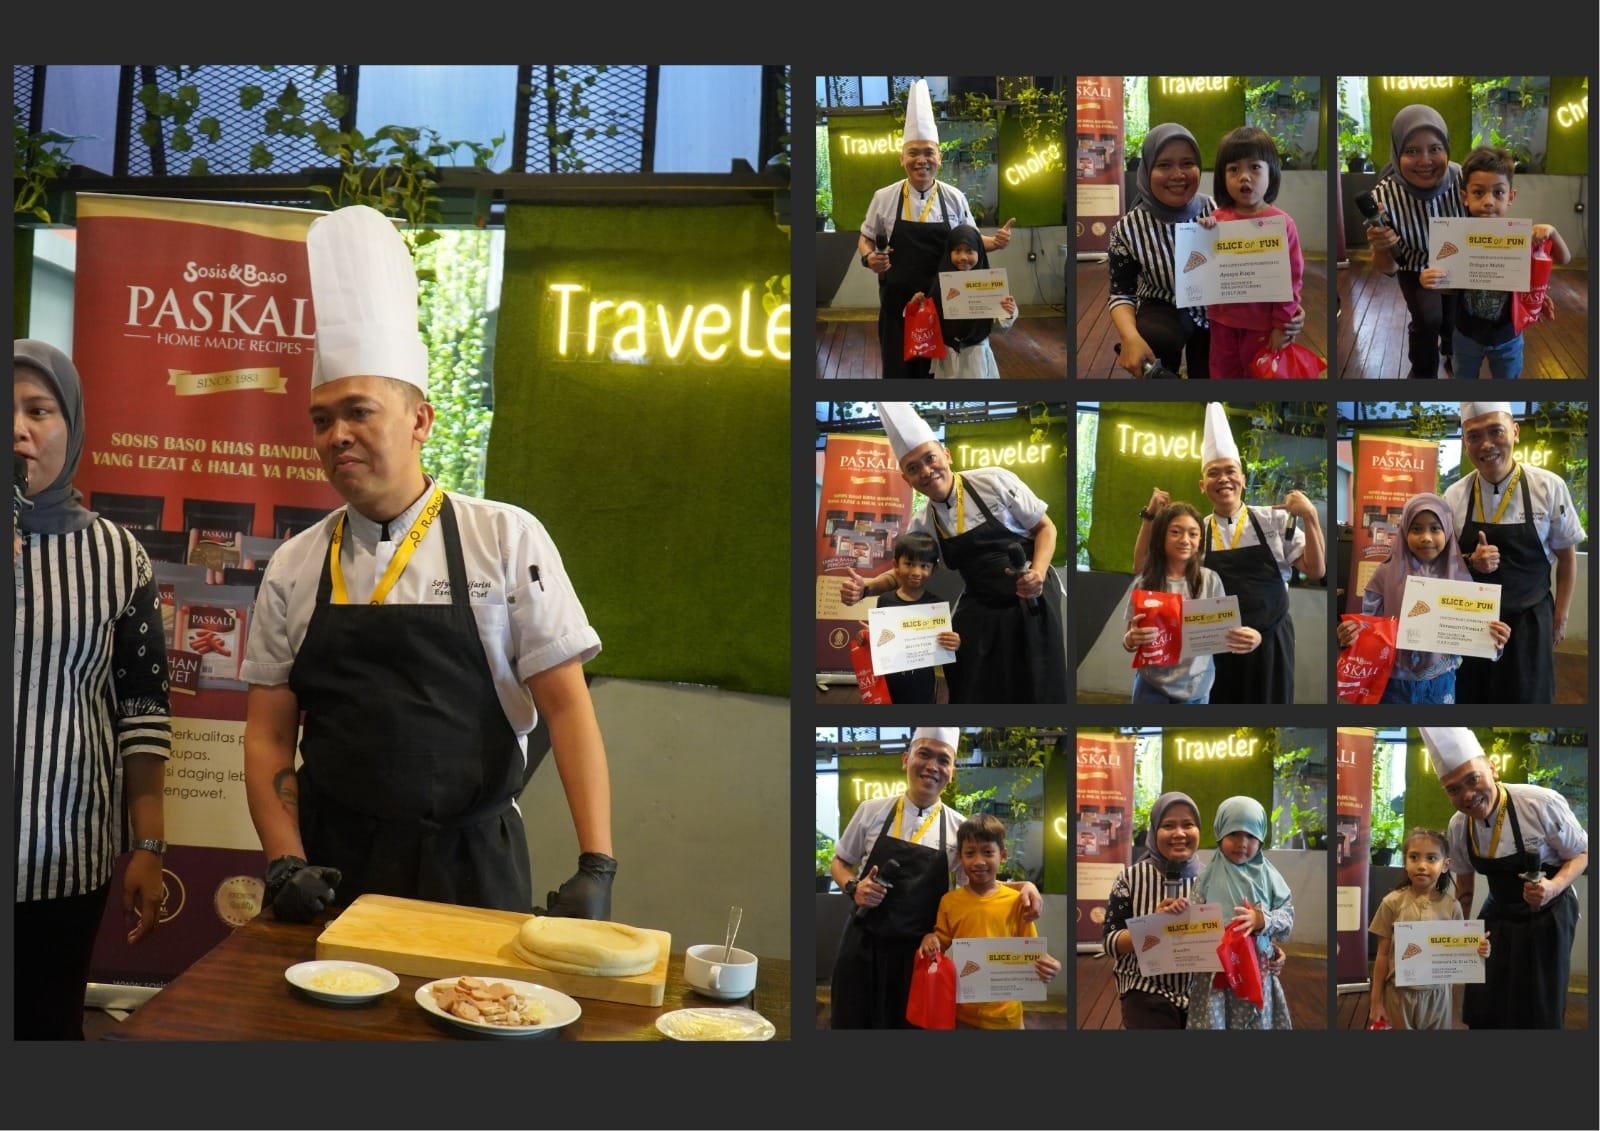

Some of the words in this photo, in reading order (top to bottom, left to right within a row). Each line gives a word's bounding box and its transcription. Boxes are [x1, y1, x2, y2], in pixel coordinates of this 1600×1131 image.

[1077, 85, 1112, 98] SKALI
[840, 134, 904, 156] Travele
[1216, 241, 1243, 250] SLICE
[1259, 239, 1280, 248] FUN
[1469, 236, 1493, 244] SLICE
[1506, 238, 1525, 246] FUN
[183, 261, 288, 287] Sosis&Baso
[124, 284, 316, 340] PASKAL
[548, 283, 792, 362] Travele
[157, 332, 201, 348] HOME
[204, 337, 246, 351] MADE
[250, 339, 303, 355] RECIPES
[196, 375, 232, 389] SINCE
[235, 373, 259, 385] 1983
[111, 432, 159, 449] SOSIS
[164, 436, 206, 453] BASO
[211, 440, 254, 457] KHAS
[259, 443, 321, 462] BANDUN
[1117, 423, 1204, 460] Travel
[840, 455, 900, 471] PASKALI
[957, 443, 1052, 467] Traveler
[1371, 455, 1425, 470] PASKALI
[1512, 446, 1553, 467] eler
[91, 451, 133, 468] YANG
[138, 455, 188, 472] LEZAT
[191, 458, 203, 473] &
[207, 460, 257, 477] HALAL
[261, 464, 281, 479] YA
[285, 466, 329, 482] PASK
[201, 528, 234, 539] PASKALI
[1441, 598, 1464, 607] SLICE
[1476, 601, 1494, 610] FUN
[191, 614, 234, 627] PASKALI
[167, 658, 198, 673] HAN
[1175, 734, 1259, 761] Traveler
[177, 766, 225, 783] daging
[227, 767, 247, 782] leb
[162, 786, 227, 801] engawet.
[852, 778, 907, 801] Trave
